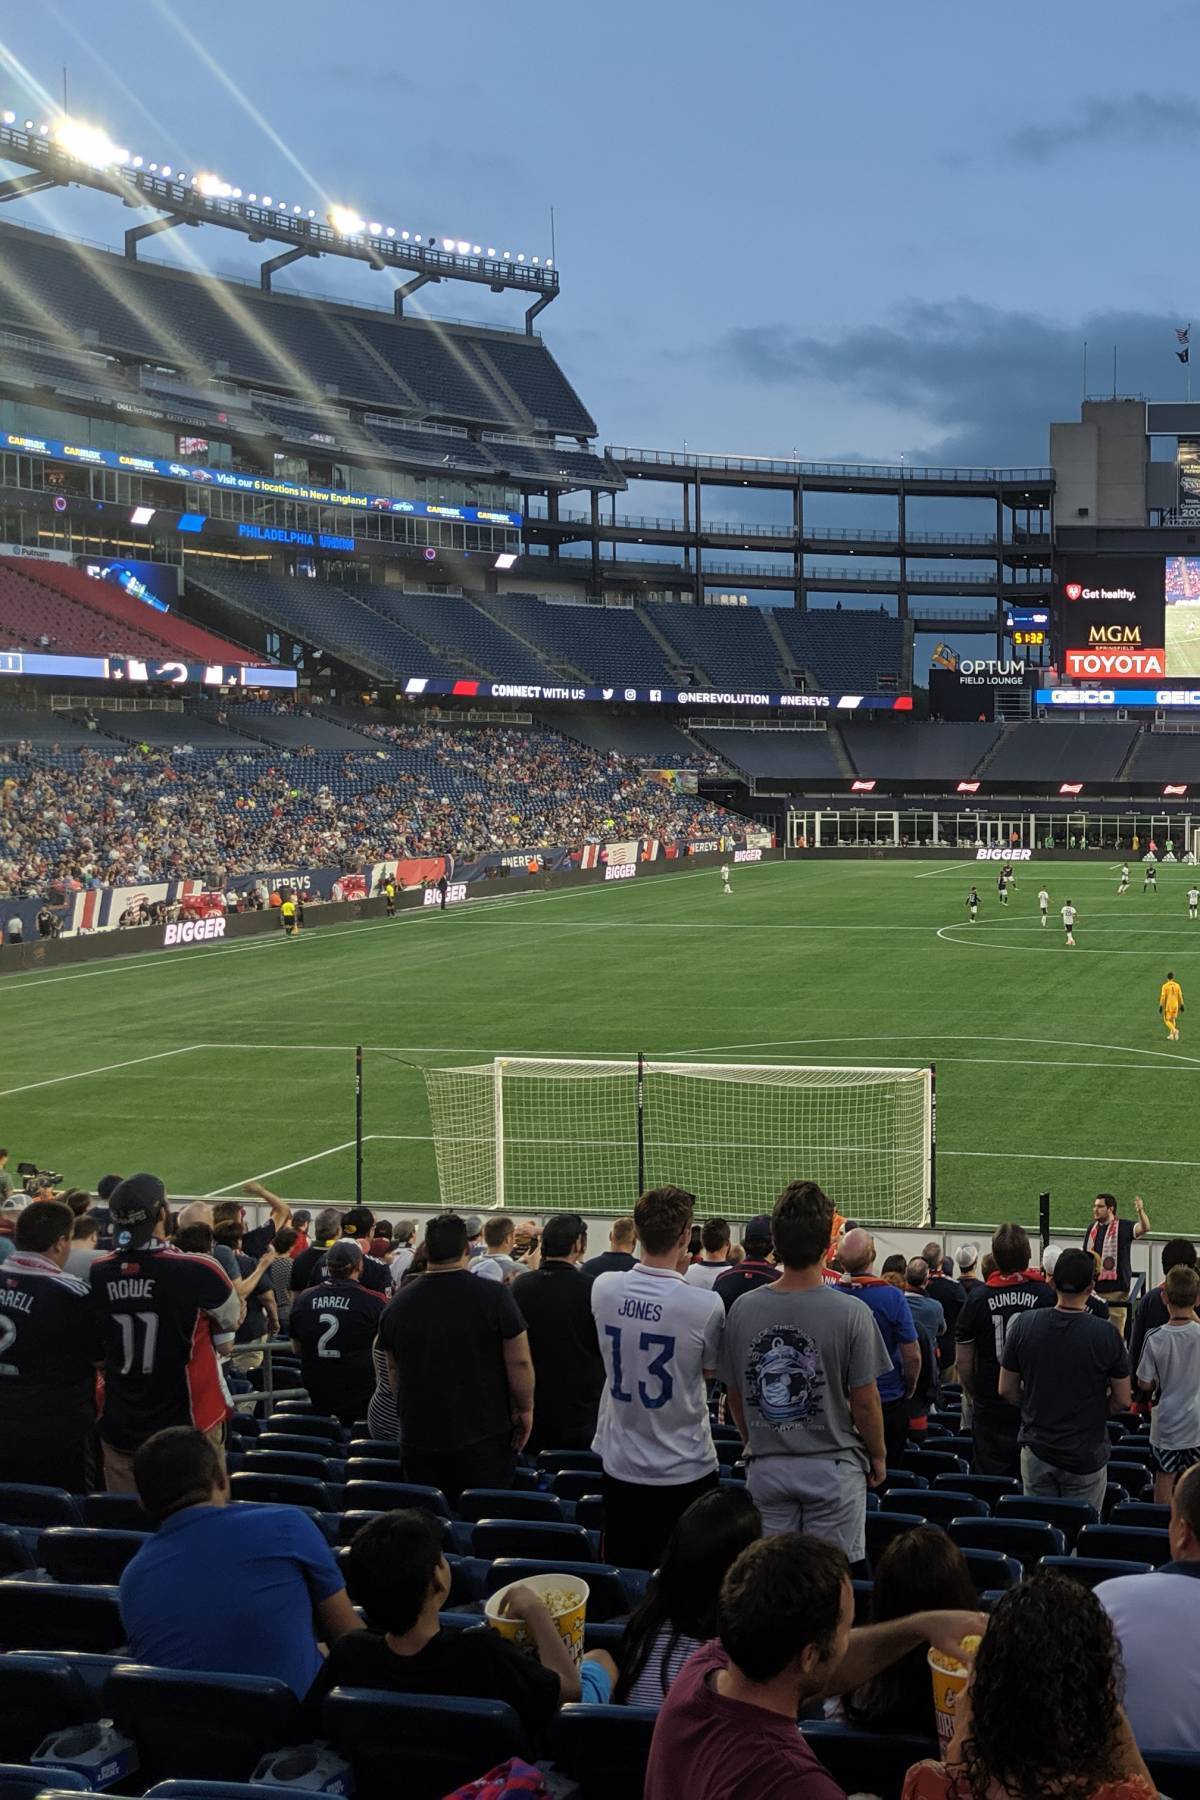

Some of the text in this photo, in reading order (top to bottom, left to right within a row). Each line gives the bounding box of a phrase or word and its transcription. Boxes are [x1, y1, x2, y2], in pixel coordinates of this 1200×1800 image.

[216, 473, 368, 506] Visit our 6 locations in New England
[239, 524, 314, 545] PHILADELPHIA
[21, 548, 50, 558] Putnam
[1082, 588, 1136, 601] Get healthy.
[1088, 625, 1141, 642] MGM
[960, 660, 1025, 675] OPTUM
[1070, 655, 1161, 673] TOYOTA
[491, 684, 830, 707] CONNECT WITH US @NEREVOLUTION #NEREVS
[1051, 690, 1115, 704] GEICO
[733, 849, 762, 862] BIGGER
[976, 849, 1032, 860] BIGGER
[605, 863, 636, 880] BIGGER
[164, 917, 226, 946] BIGGER
[107, 1279, 156, 1301] ROWE
[312, 1296, 351, 1310] FARRELL
[618, 1298, 663, 1322] JONES
[988, 1292, 1039, 1311] BUNBURY
[111, 1311, 159, 1375] 11
[317, 1313, 341, 1358] 2
[605, 1324, 676, 1409] 13
